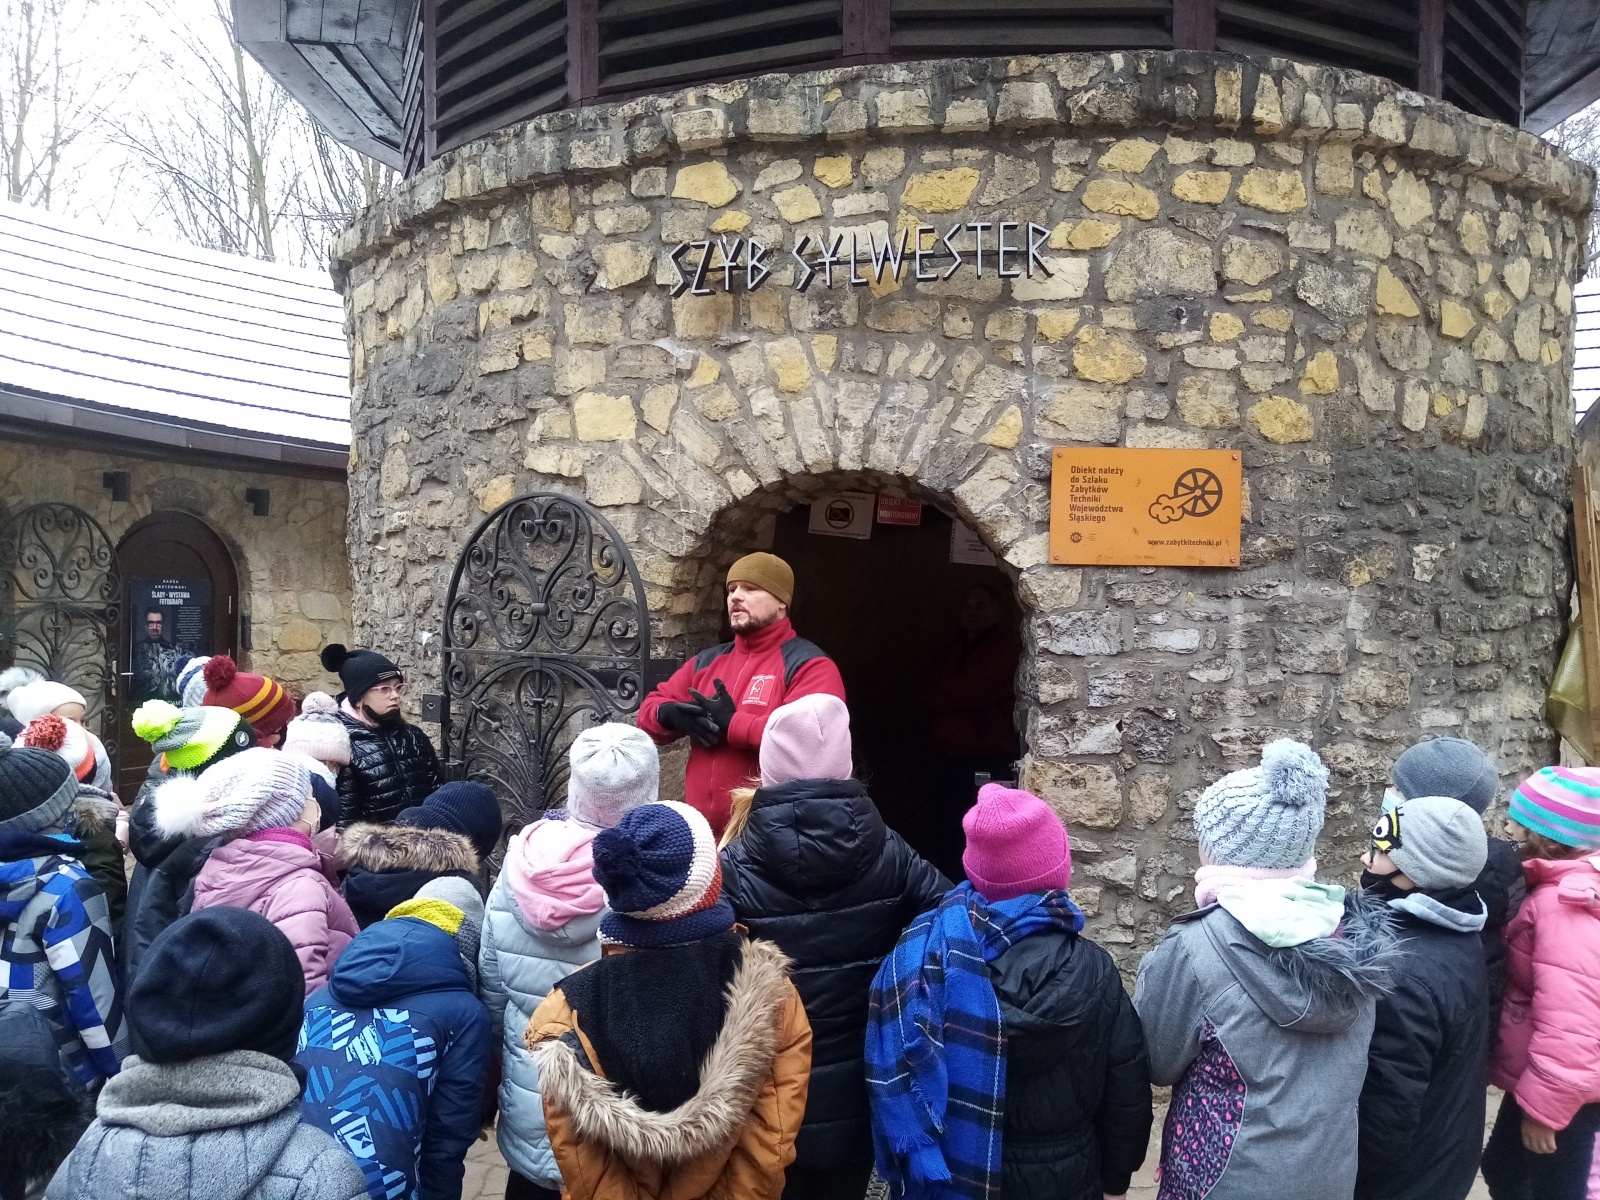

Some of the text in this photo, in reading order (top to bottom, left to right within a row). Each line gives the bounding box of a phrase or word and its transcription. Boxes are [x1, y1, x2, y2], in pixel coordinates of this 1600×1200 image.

[668, 221, 1054, 296] SZYB SYLWESTER
[1070, 465, 1124, 476] Obiekt należy
[1070, 475, 1108, 484] do Szlaku
[1069, 485, 1109, 494] Zabytków
[880, 497, 901, 506] OBIEKT
[1069, 494, 1101, 503] Techniki
[1069, 504, 1124, 514] Województwa
[879, 510, 919, 520] MONITOROWANY
[1068, 513, 1106, 523] Śląskiego
[1147, 539, 1222, 547] www.zabytkitechniki.pl
[169, 591, 191, 599] WYSTAWA
